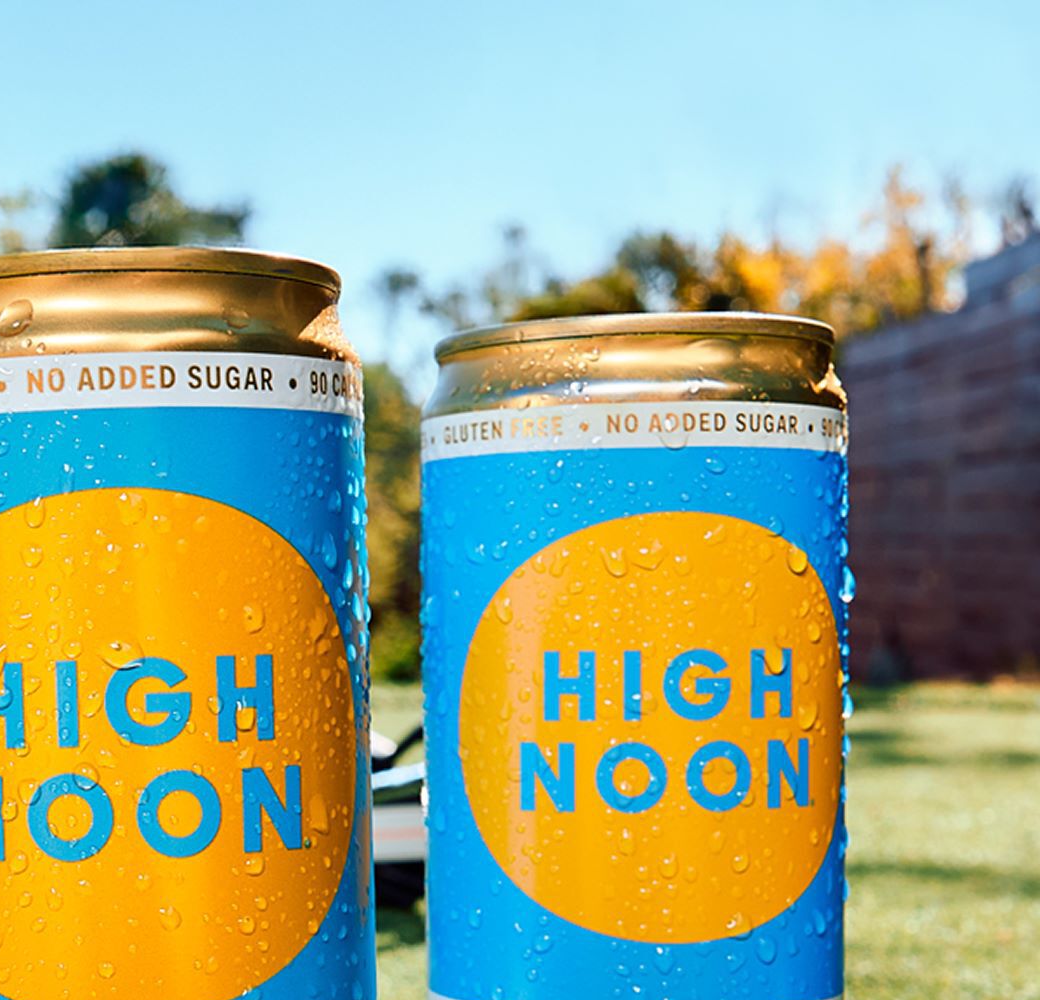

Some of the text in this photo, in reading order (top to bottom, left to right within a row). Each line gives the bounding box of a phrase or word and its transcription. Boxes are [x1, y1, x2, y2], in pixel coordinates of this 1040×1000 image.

[26, 367, 65, 393] NO
[77, 365, 177, 392] ADDED
[188, 365, 275, 391] SUGAR
[310, 370, 327, 395] 90
[444, 420, 502, 444] GLUTEN
[511, 415, 563, 438] FREE
[607, 413, 639, 434] NO
[649, 412, 727, 434] ADDED
[736, 412, 799, 434] SUGAR
[543, 648, 792, 722] HIGH
[520, 738, 810, 814] NOON
